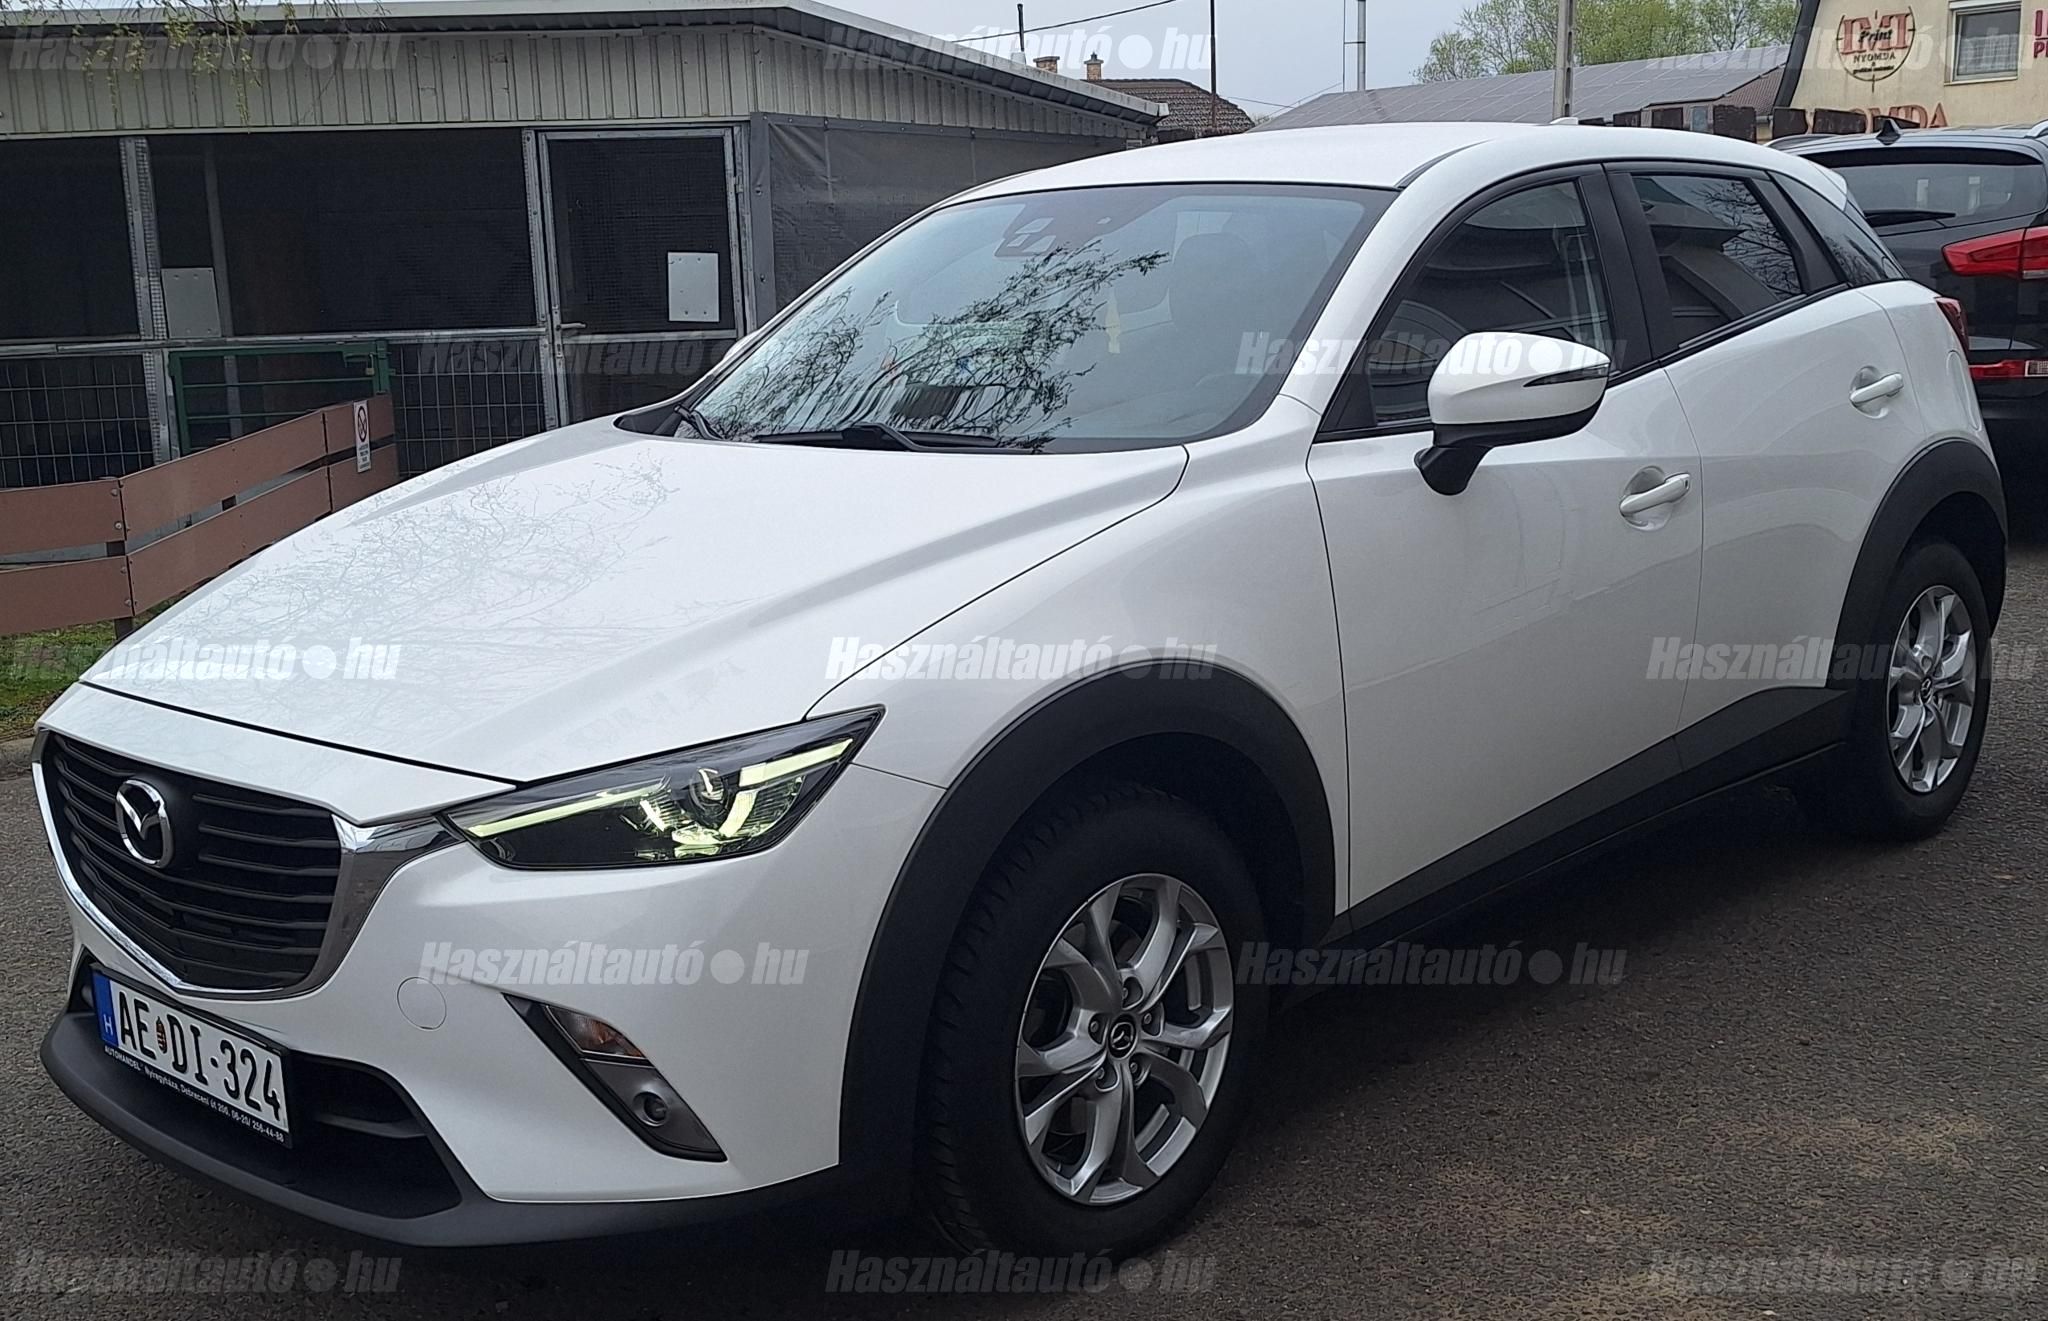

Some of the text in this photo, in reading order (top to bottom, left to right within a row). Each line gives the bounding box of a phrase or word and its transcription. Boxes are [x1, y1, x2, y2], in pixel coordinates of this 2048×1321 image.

[1858, 28, 1893, 43] Print
[1853, 52, 1896, 64] NYOMDA
[103, 1014, 114, 1032] H
[119, 991, 157, 1060] AE
